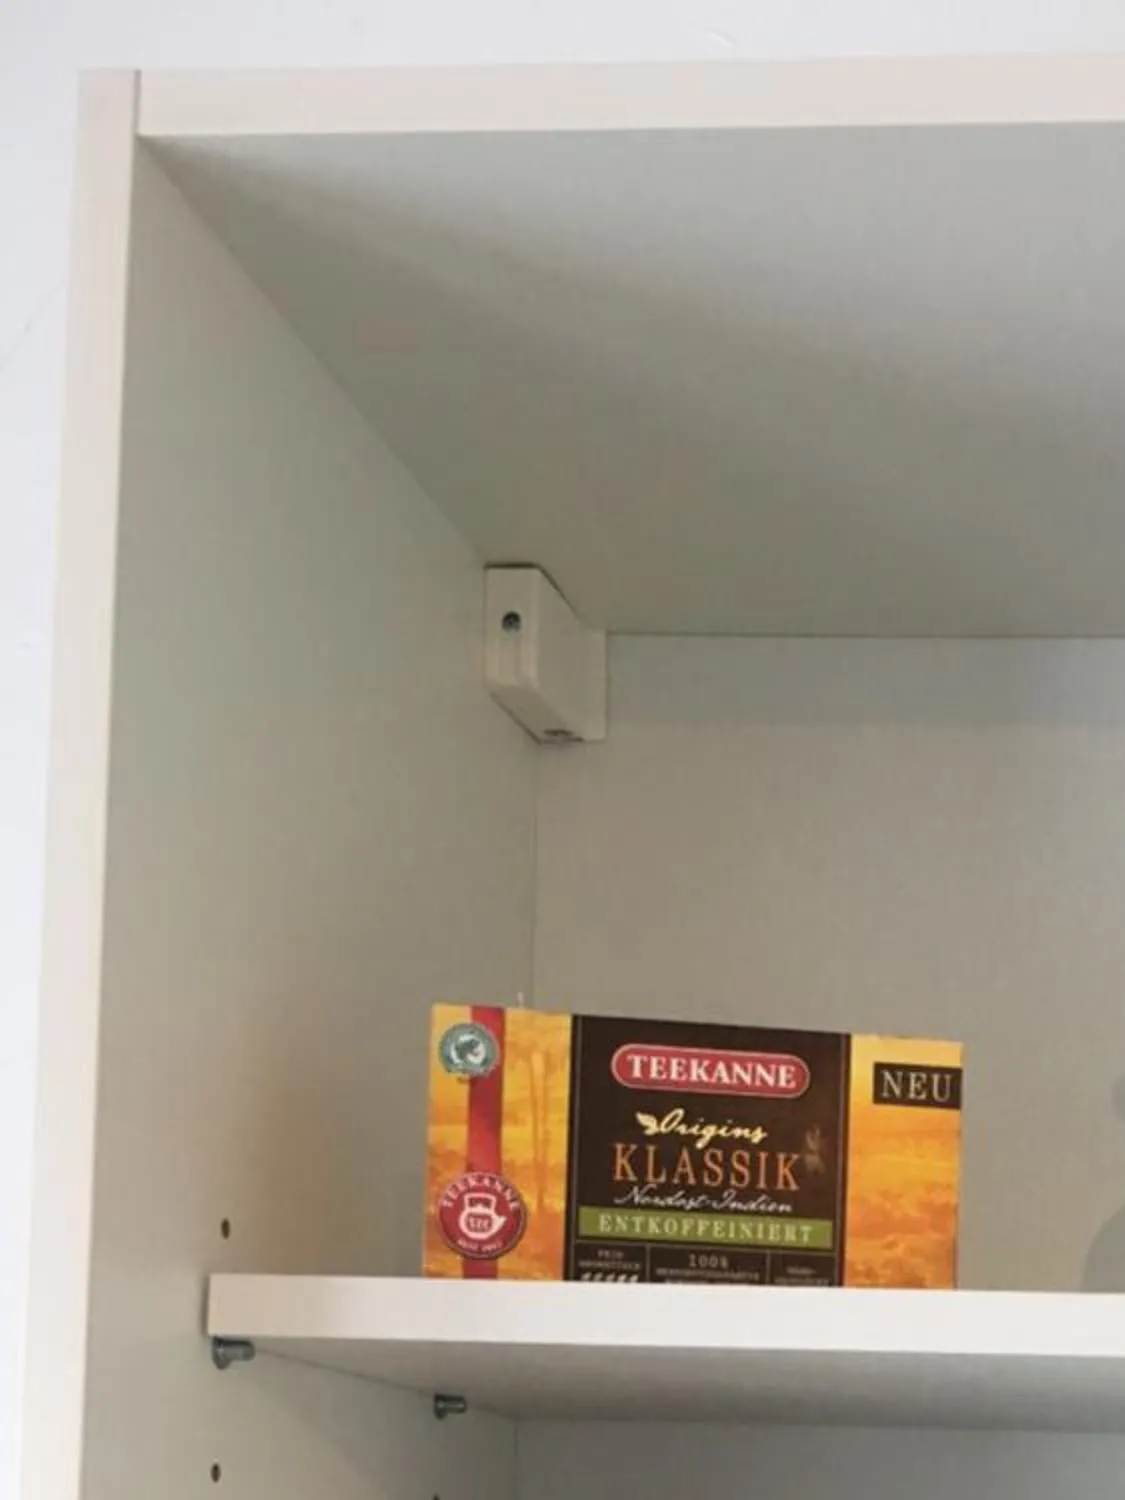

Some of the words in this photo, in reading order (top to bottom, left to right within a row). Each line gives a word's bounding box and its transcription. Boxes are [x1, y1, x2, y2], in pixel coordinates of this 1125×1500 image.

[626, 1053, 797, 1090] TEEKANNE
[879, 1069, 953, 1101] NEU
[657, 1107, 768, 1148] Origins
[612, 1142, 801, 1191] KLASSIK
[598, 1213, 814, 1243] ENTKOFFEINIERT
